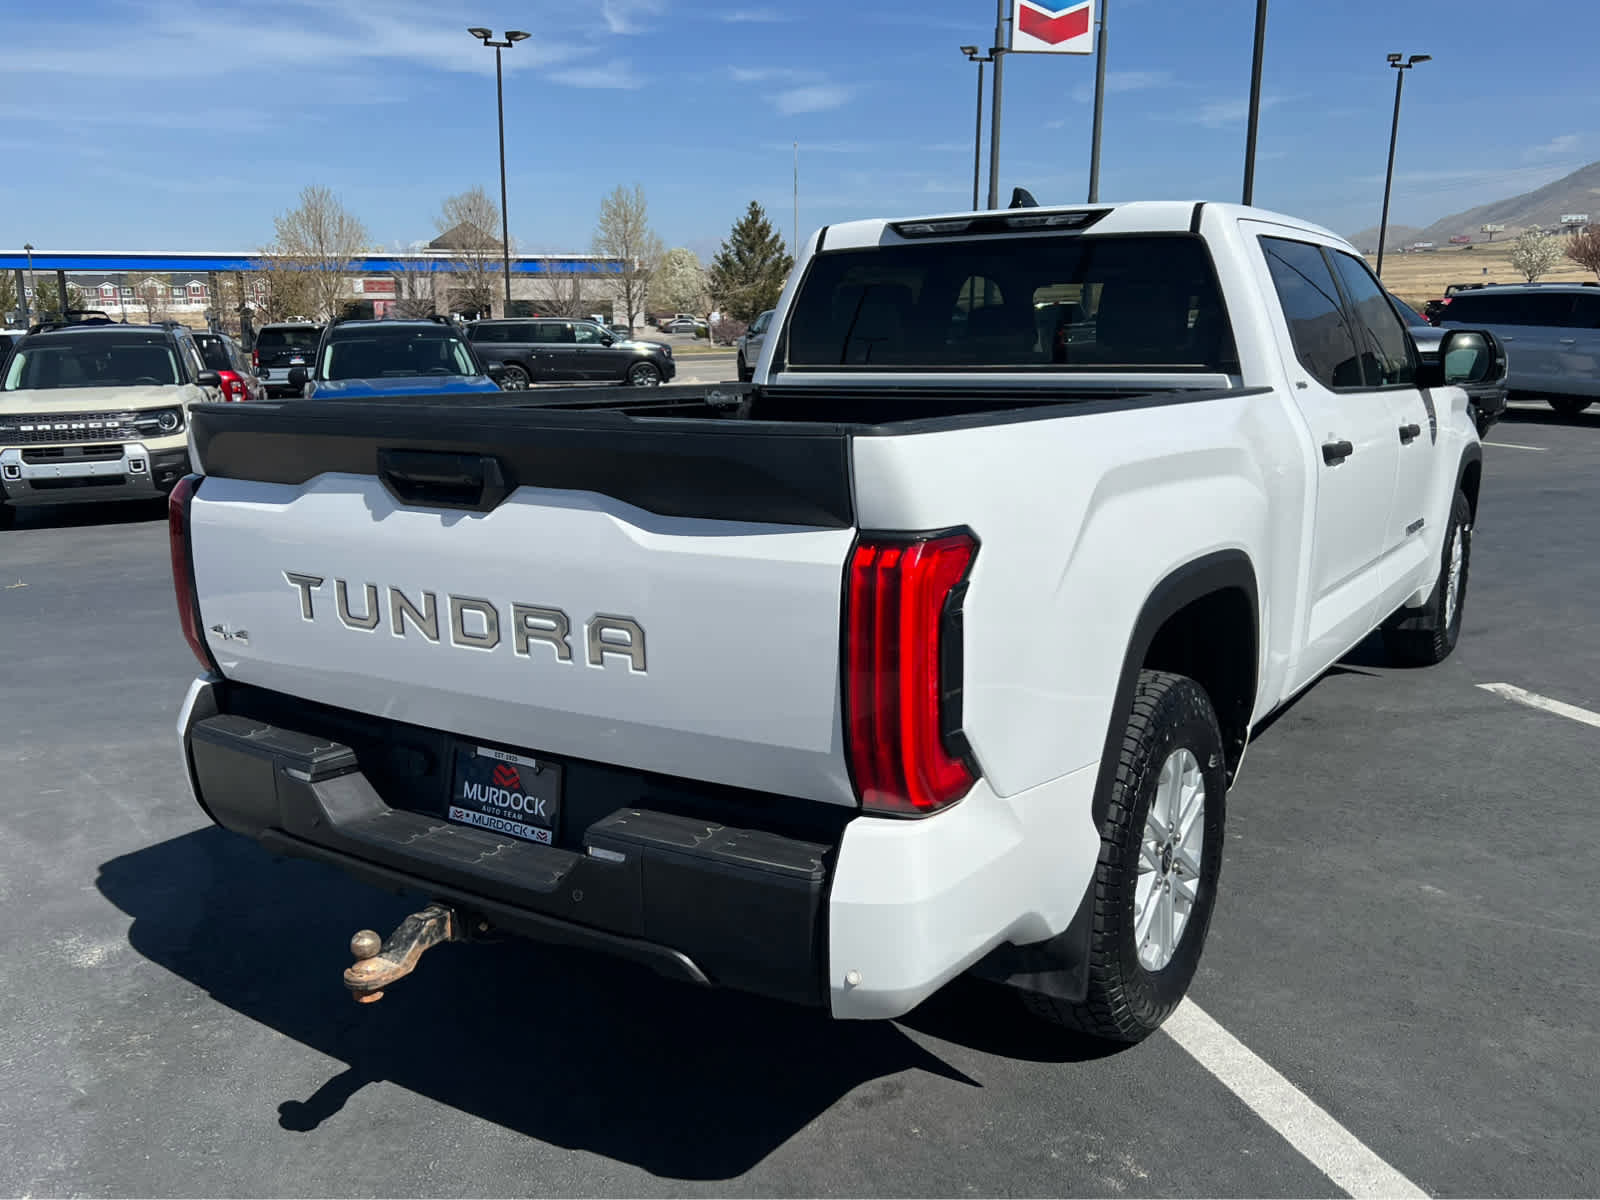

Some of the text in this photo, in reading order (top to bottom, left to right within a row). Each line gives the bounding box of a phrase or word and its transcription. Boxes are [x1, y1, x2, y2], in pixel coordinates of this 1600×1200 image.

[20, 421, 120, 431] BRONCO
[282, 569, 648, 676] TUNDRA
[463, 780, 546, 817] MURDOCK
[481, 805, 523, 820] AUTO TEAM
[472, 813, 528, 837] MURDOCK
